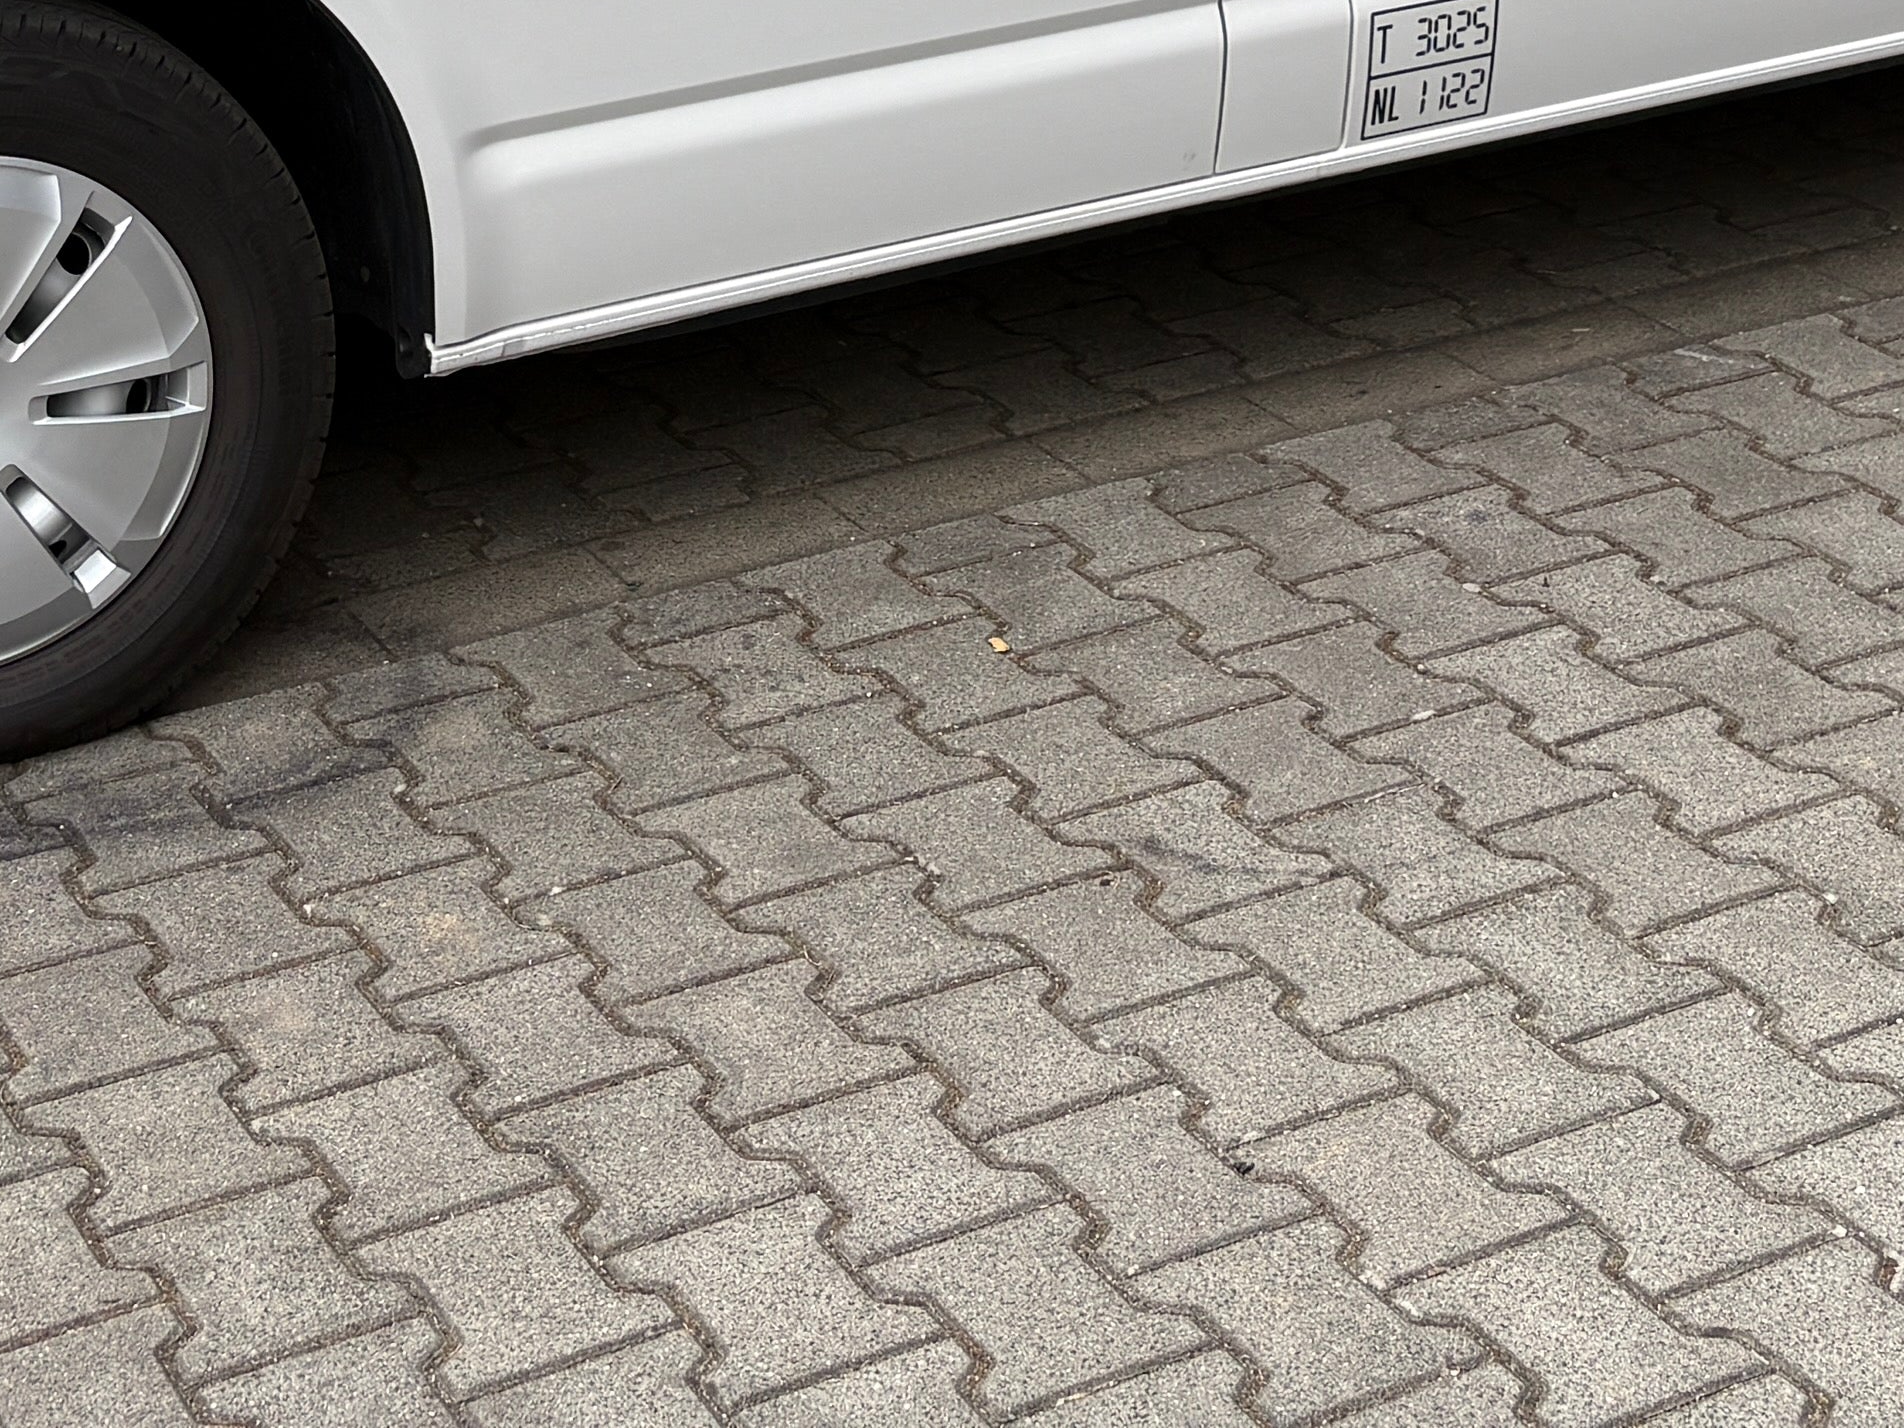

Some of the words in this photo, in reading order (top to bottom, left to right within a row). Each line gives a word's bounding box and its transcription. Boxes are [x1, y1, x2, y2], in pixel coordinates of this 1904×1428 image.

[1376, 24, 1394, 64] T
[1415, 6, 1490, 57] 3025
[1370, 85, 1400, 126] NL
